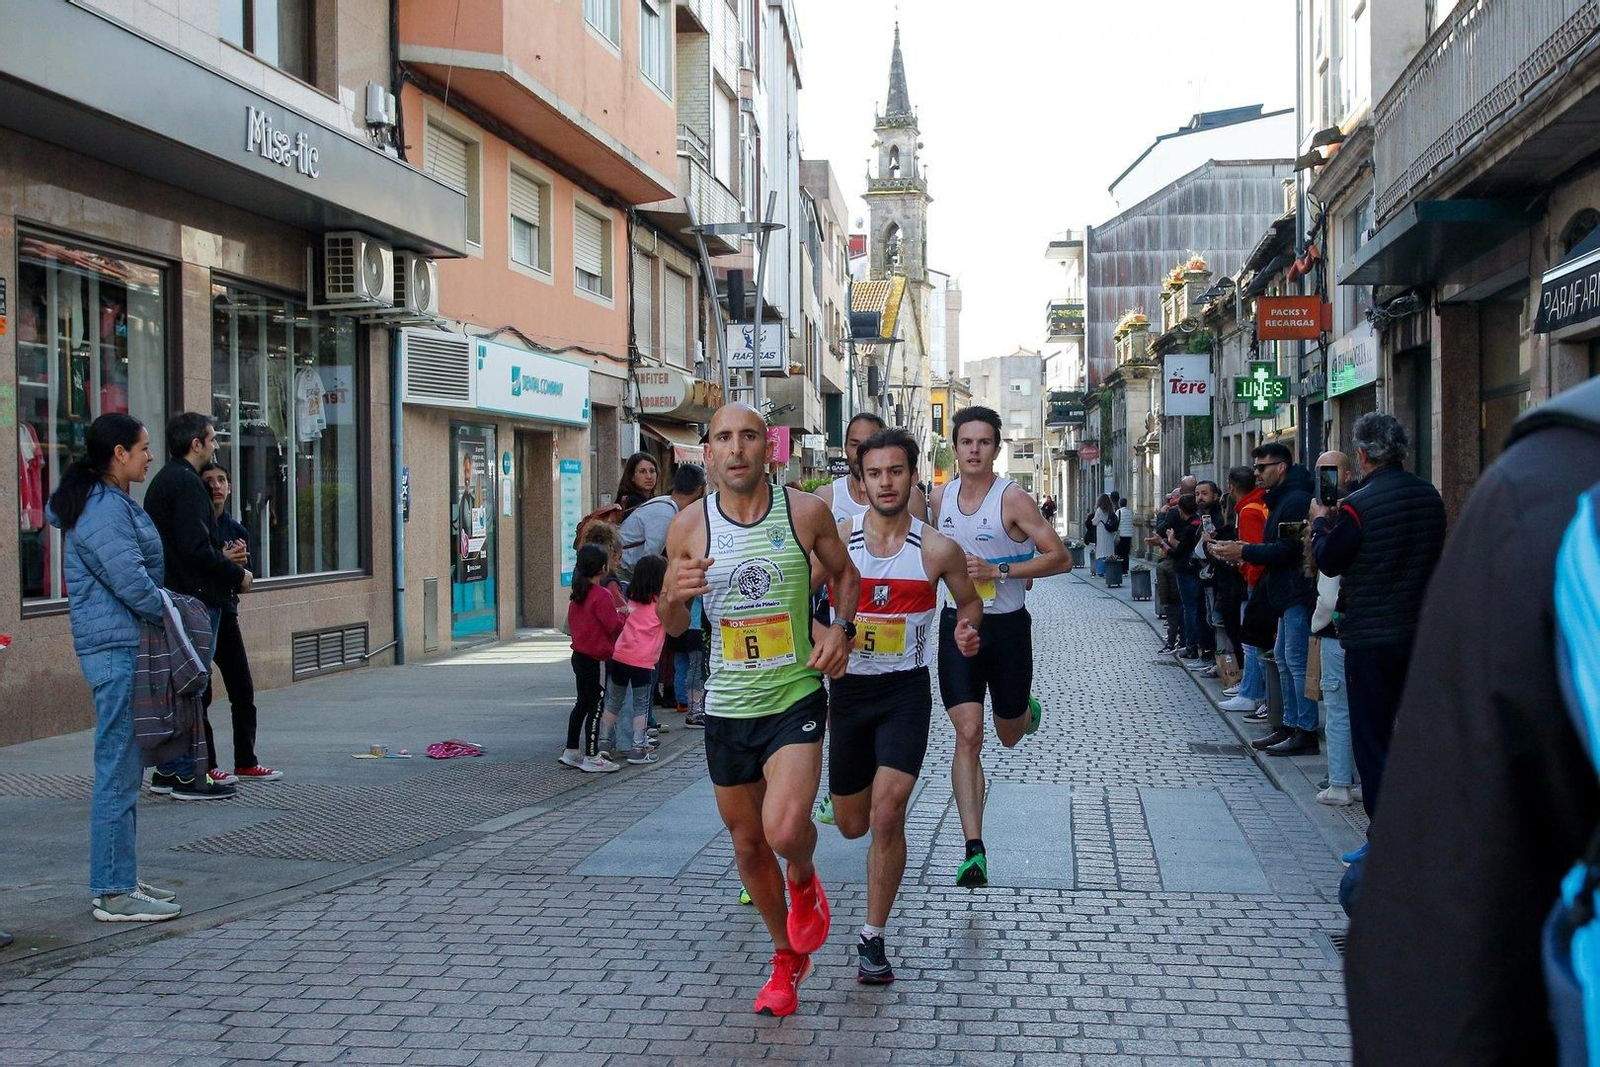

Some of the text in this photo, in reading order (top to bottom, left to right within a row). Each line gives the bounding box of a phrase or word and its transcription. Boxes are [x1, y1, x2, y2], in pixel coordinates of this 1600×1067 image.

[1543, 271, 1600, 323] PARAFAR
[1270, 308, 1309, 316] PACKS Y
[1265, 319, 1315, 327] RECARGAS
[732, 351, 776, 360] RAFGAS
[1169, 378, 1206, 394] Tere
[745, 635, 760, 659] 6
[864, 631, 876, 651] 5
